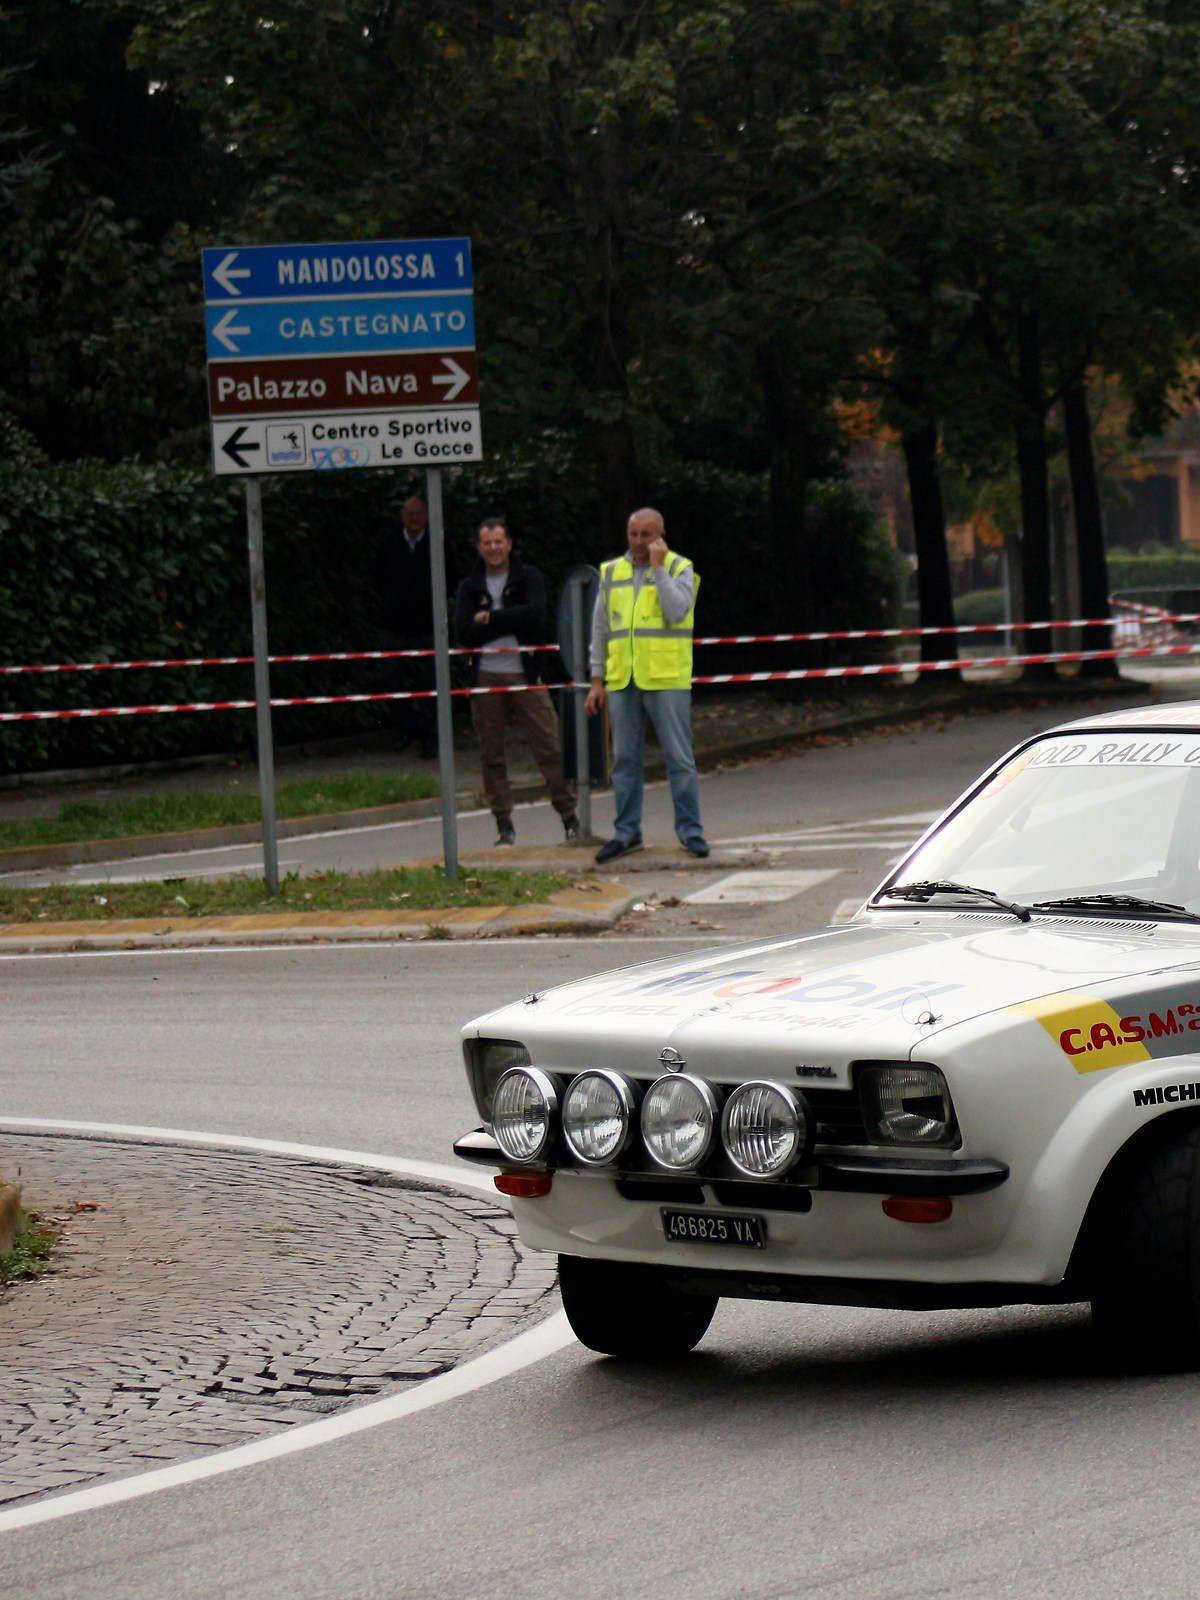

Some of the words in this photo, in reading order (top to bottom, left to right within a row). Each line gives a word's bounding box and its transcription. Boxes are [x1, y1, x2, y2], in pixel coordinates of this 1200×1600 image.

[278, 254, 436, 285] MANDOLOSSA
[455, 252, 465, 277] 1
[279, 310, 466, 338] CASTEGNATO
[217, 375, 327, 402] Palazzo
[346, 370, 418, 395] Nava
[312, 422, 379, 441] Centro
[388, 418, 472, 438] Sportivo
[381, 443, 403, 459] Le
[414, 441, 473, 458] Gocce
[1032, 743, 1087, 765] OLD
[1089, 742, 1182, 764] RALLY
[614, 970, 966, 1011] Mobil
[565, 1003, 680, 1018] OPEL
[729, 1004, 866, 1032] Longhi
[1059, 1009, 1185, 1056] C.A.S.M.
[670, 1215, 728, 1239] 486825
[734, 1221, 754, 1242] VA
